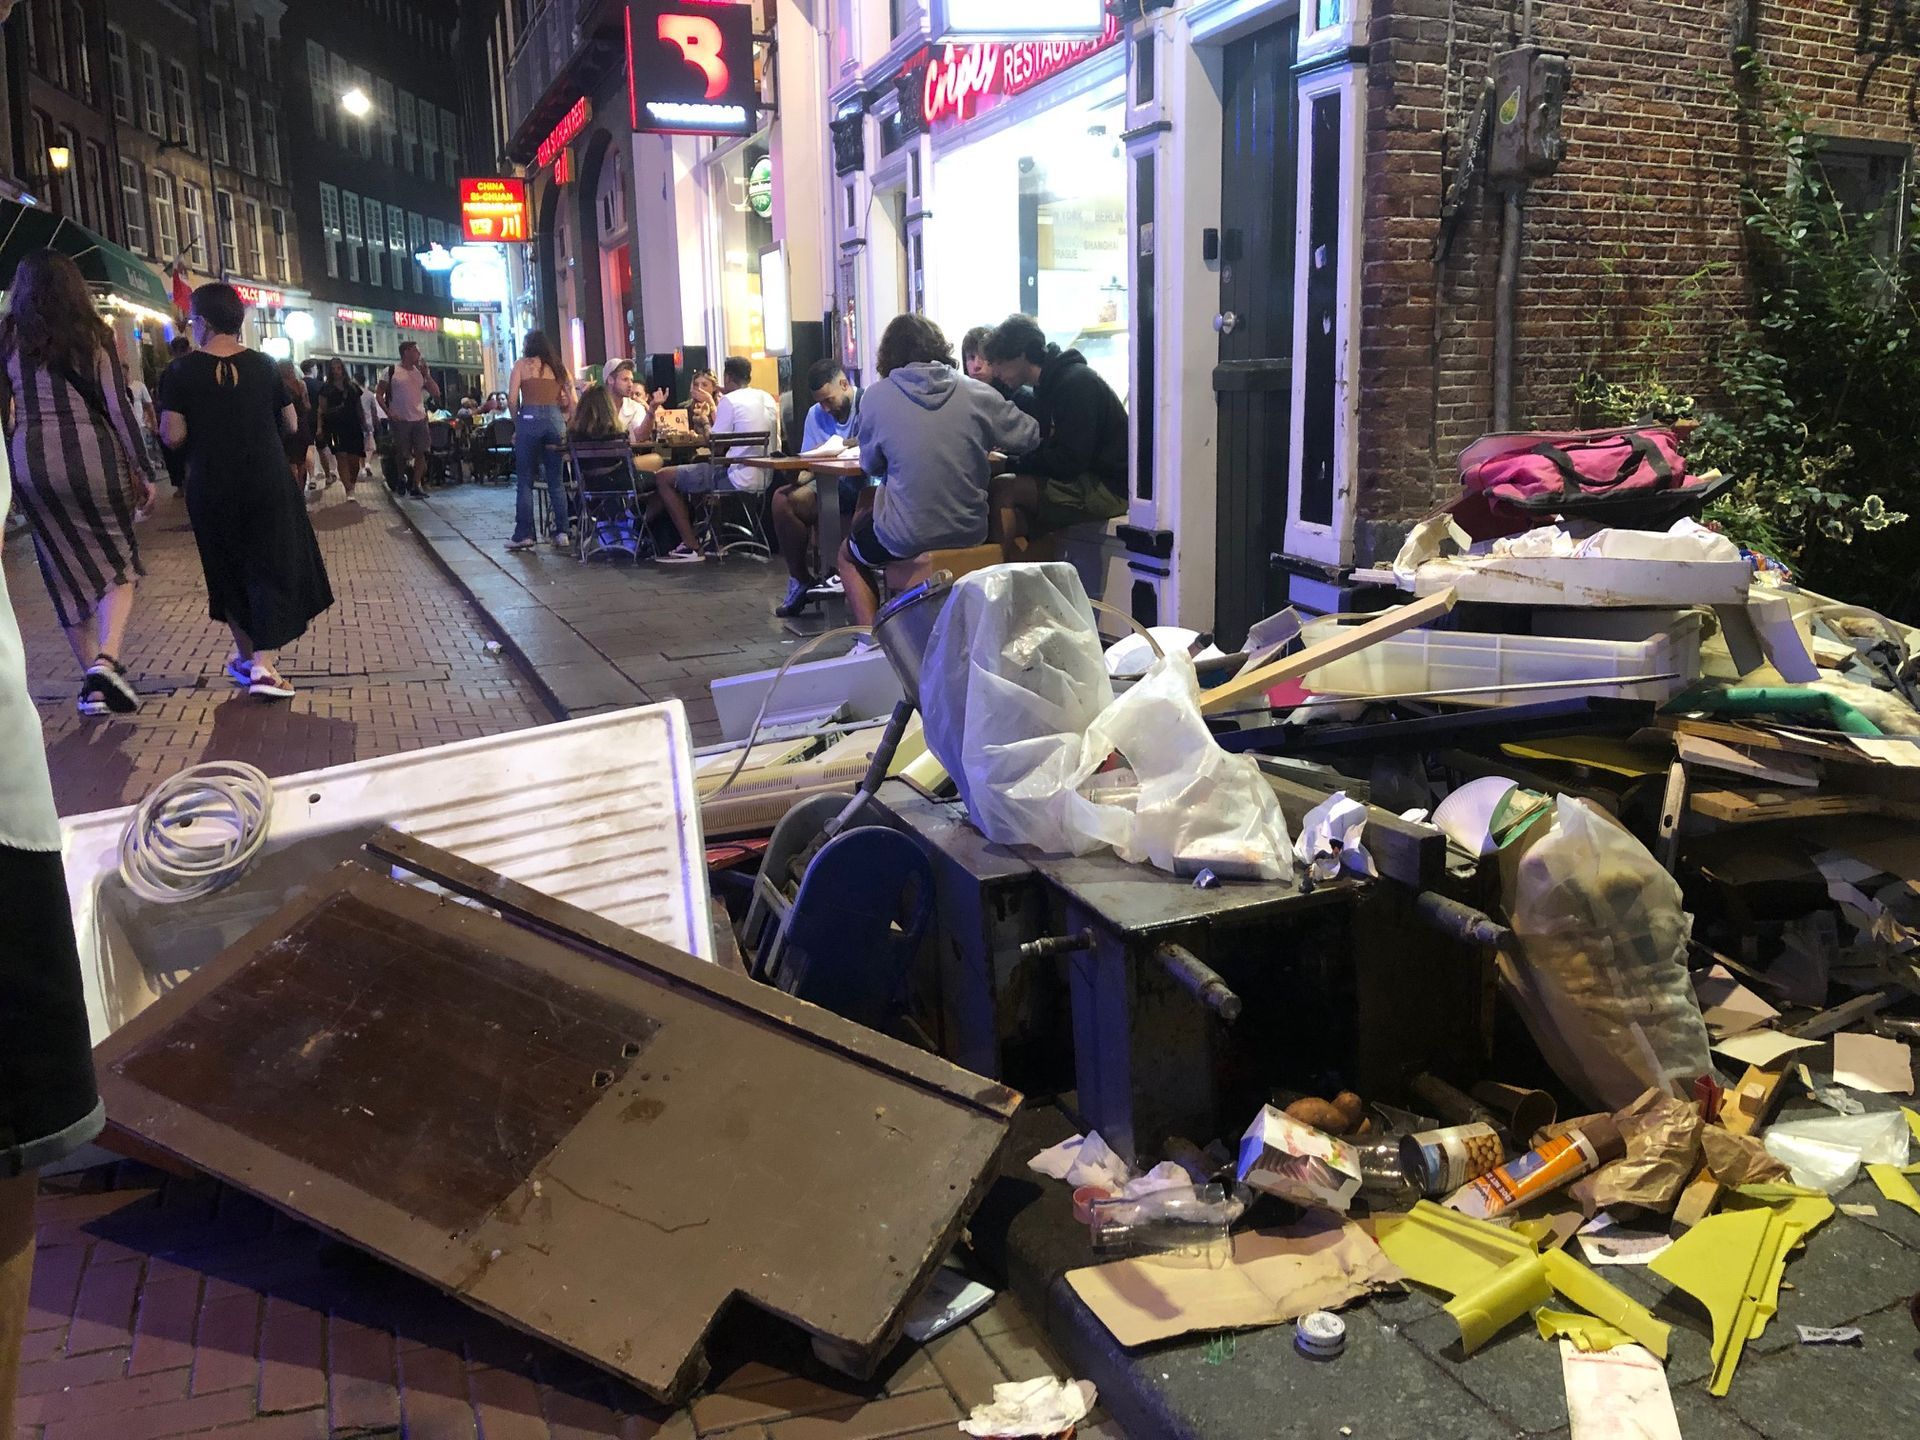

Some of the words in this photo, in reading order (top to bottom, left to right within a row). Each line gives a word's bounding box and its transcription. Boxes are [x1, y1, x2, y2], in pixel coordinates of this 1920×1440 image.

[477, 182, 505, 191] CHINA
[470, 192, 513, 201] SI-CHUAN
[395, 311, 437, 330] RESTAURANT
